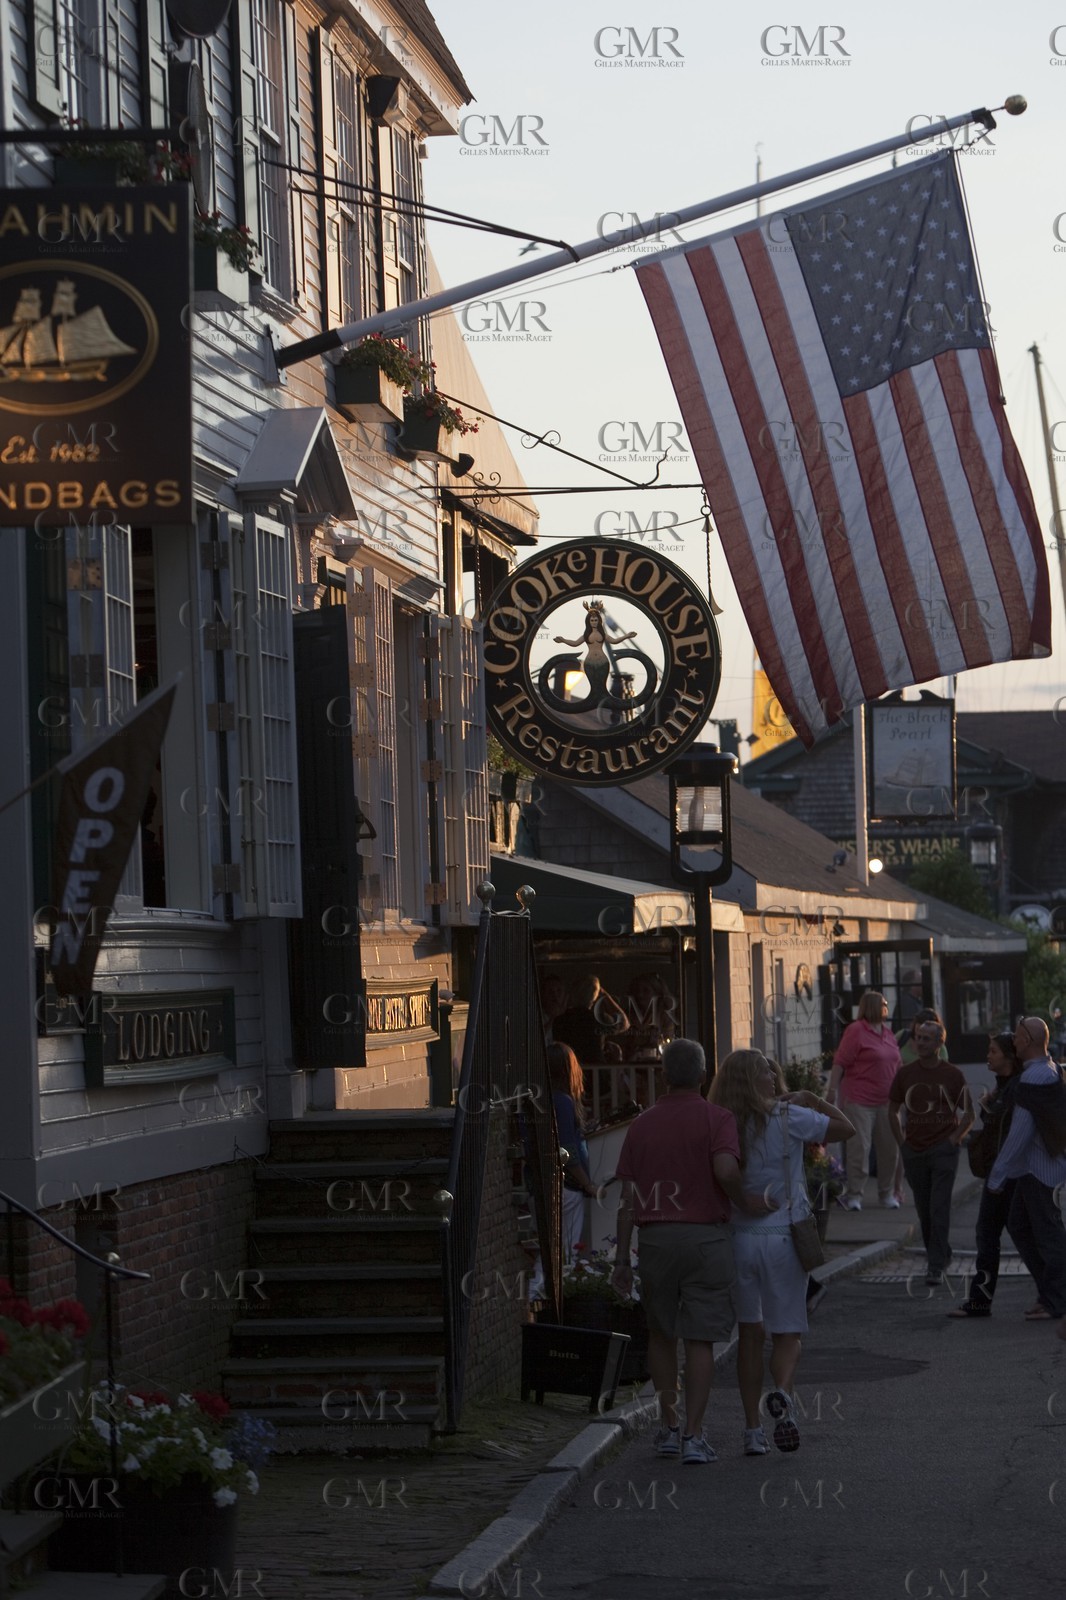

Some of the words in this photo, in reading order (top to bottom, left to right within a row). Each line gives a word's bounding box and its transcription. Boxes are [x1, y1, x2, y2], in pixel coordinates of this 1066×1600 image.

[50, 443, 100, 463] 1982
[591, 547, 711, 668] HOUSE
[493, 677, 705, 774] Restaurant
[879, 708, 902, 723] The
[907, 708, 947, 724] Black
[889, 726, 933, 741] Pearl
[50, 766, 126, 966] OPEN
[118, 1009, 210, 1061] LODGING
